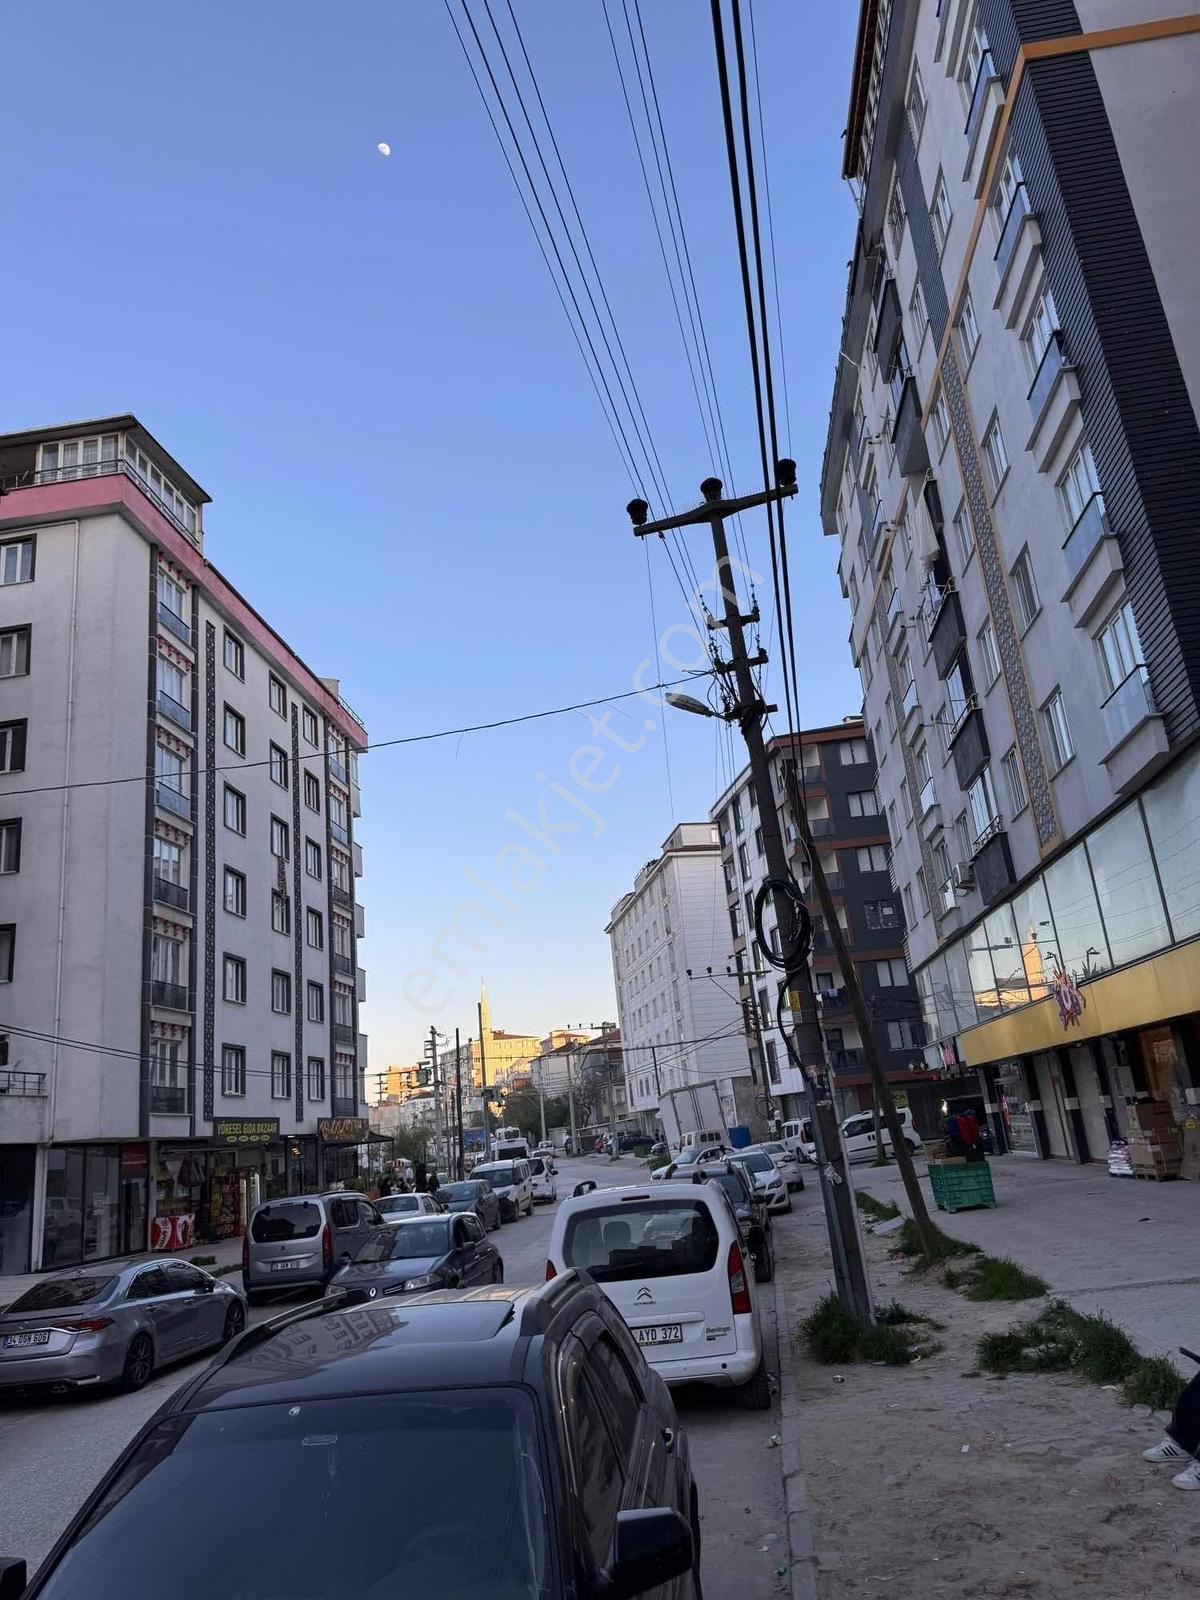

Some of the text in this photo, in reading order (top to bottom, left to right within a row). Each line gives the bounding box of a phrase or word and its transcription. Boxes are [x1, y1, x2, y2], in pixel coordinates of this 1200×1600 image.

[217, 1121, 242, 1135] YÖRESEL
[243, 1123, 256, 1134] GIDA
[639, 1327, 680, 1342] AYD 372
